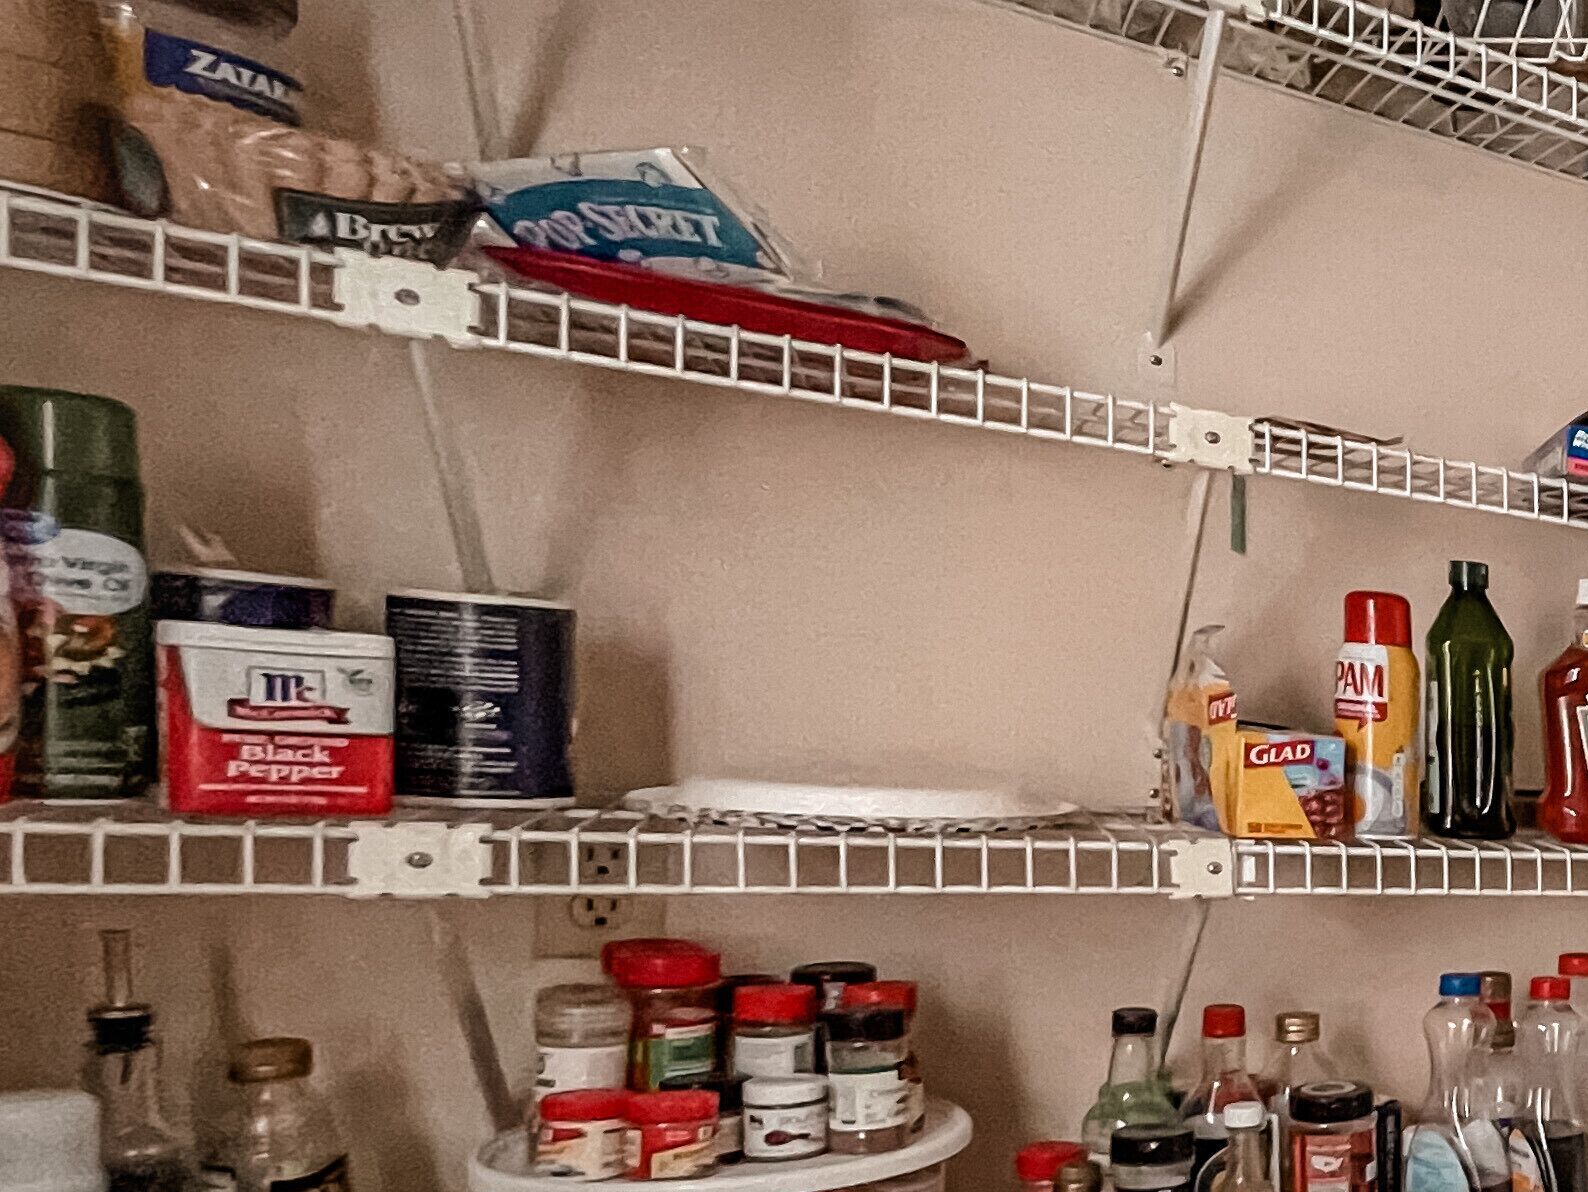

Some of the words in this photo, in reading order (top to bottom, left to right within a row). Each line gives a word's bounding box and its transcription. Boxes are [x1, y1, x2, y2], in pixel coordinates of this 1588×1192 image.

[1336, 660, 1387, 699] PAM
[238, 744, 331, 764] Black
[1249, 743, 1311, 766] GLAD
[226, 761, 345, 780] Pepper
